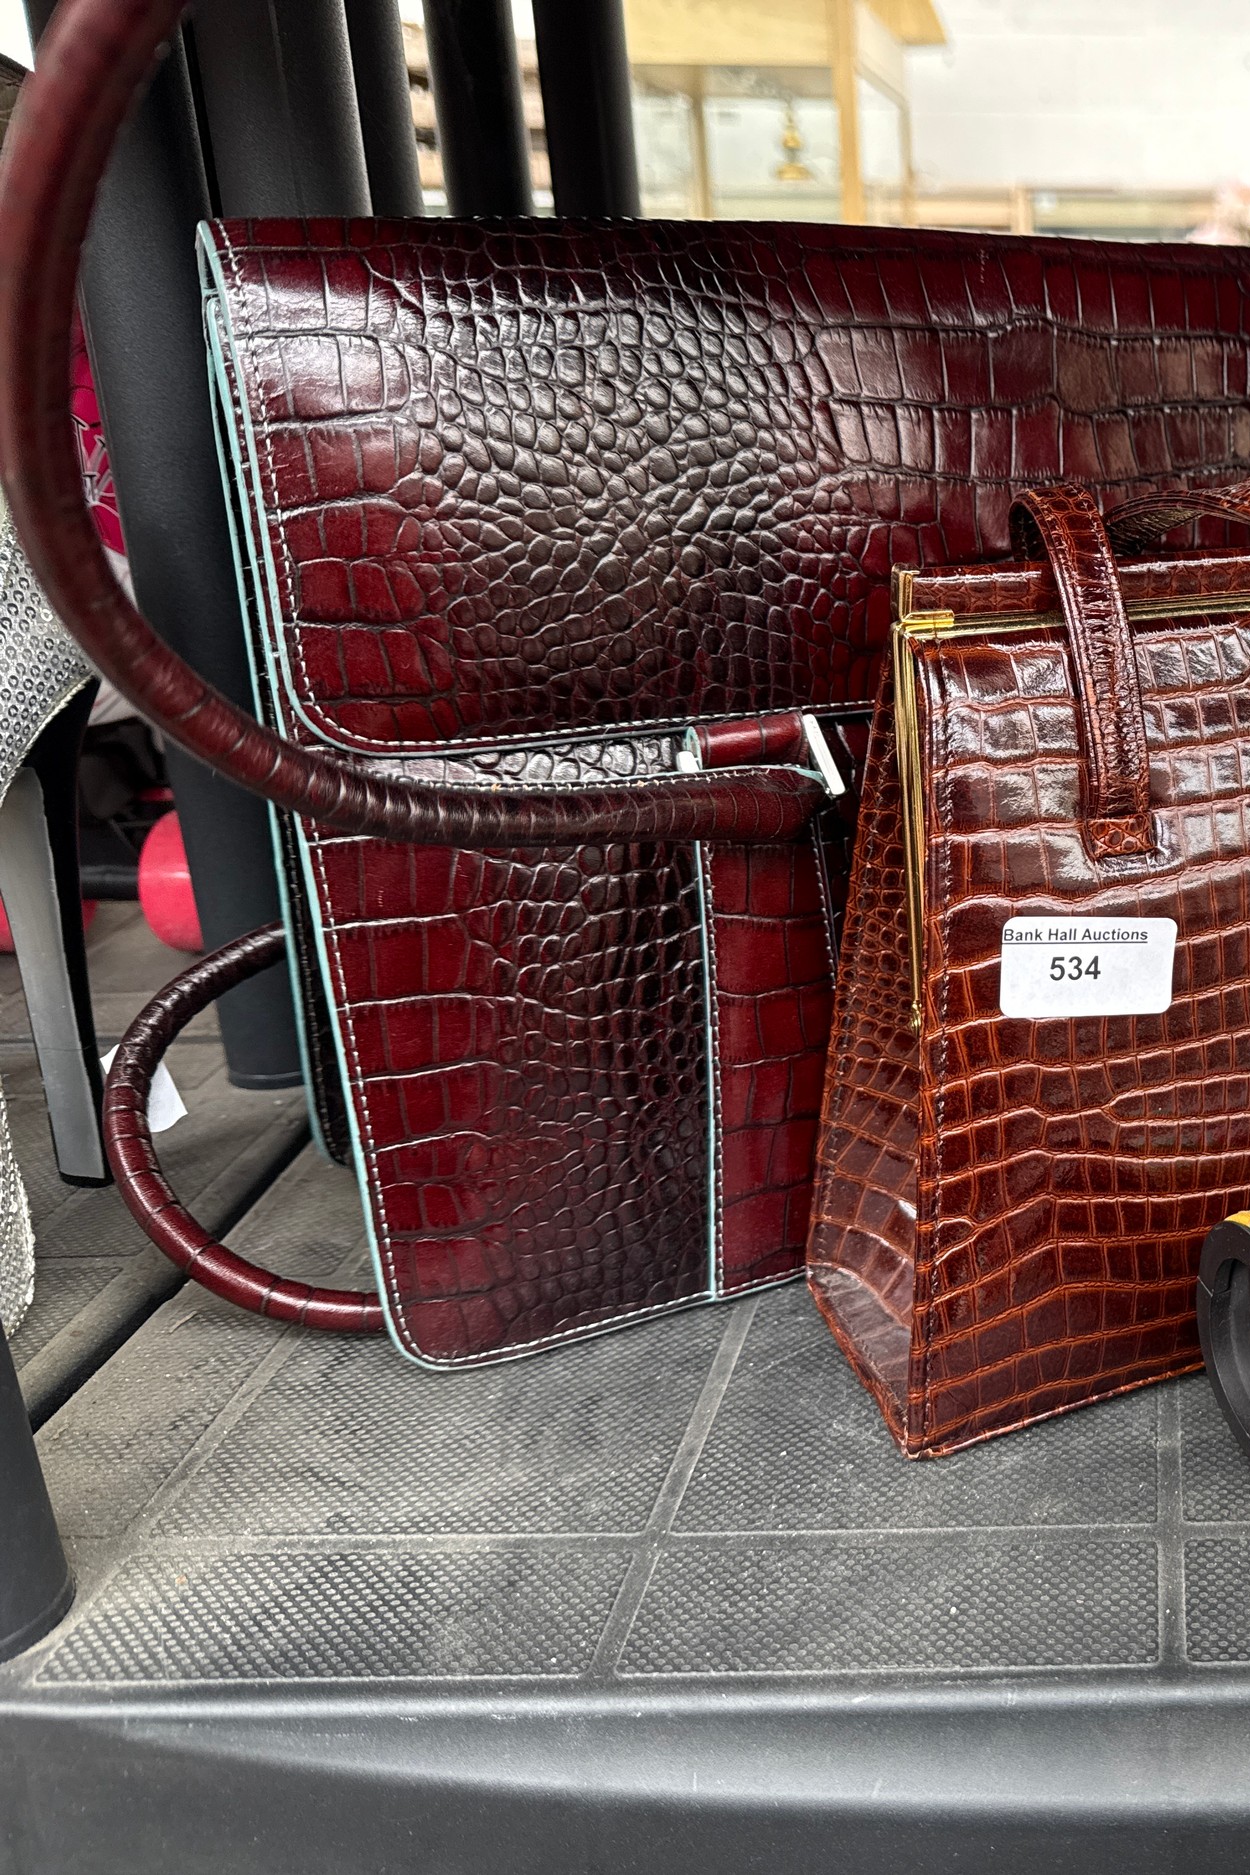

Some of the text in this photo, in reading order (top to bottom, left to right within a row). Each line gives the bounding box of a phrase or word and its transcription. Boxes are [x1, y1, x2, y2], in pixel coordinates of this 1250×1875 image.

[1003, 927, 1148, 941] Bank Hall Auctions
[1049, 955, 1101, 981] 534
